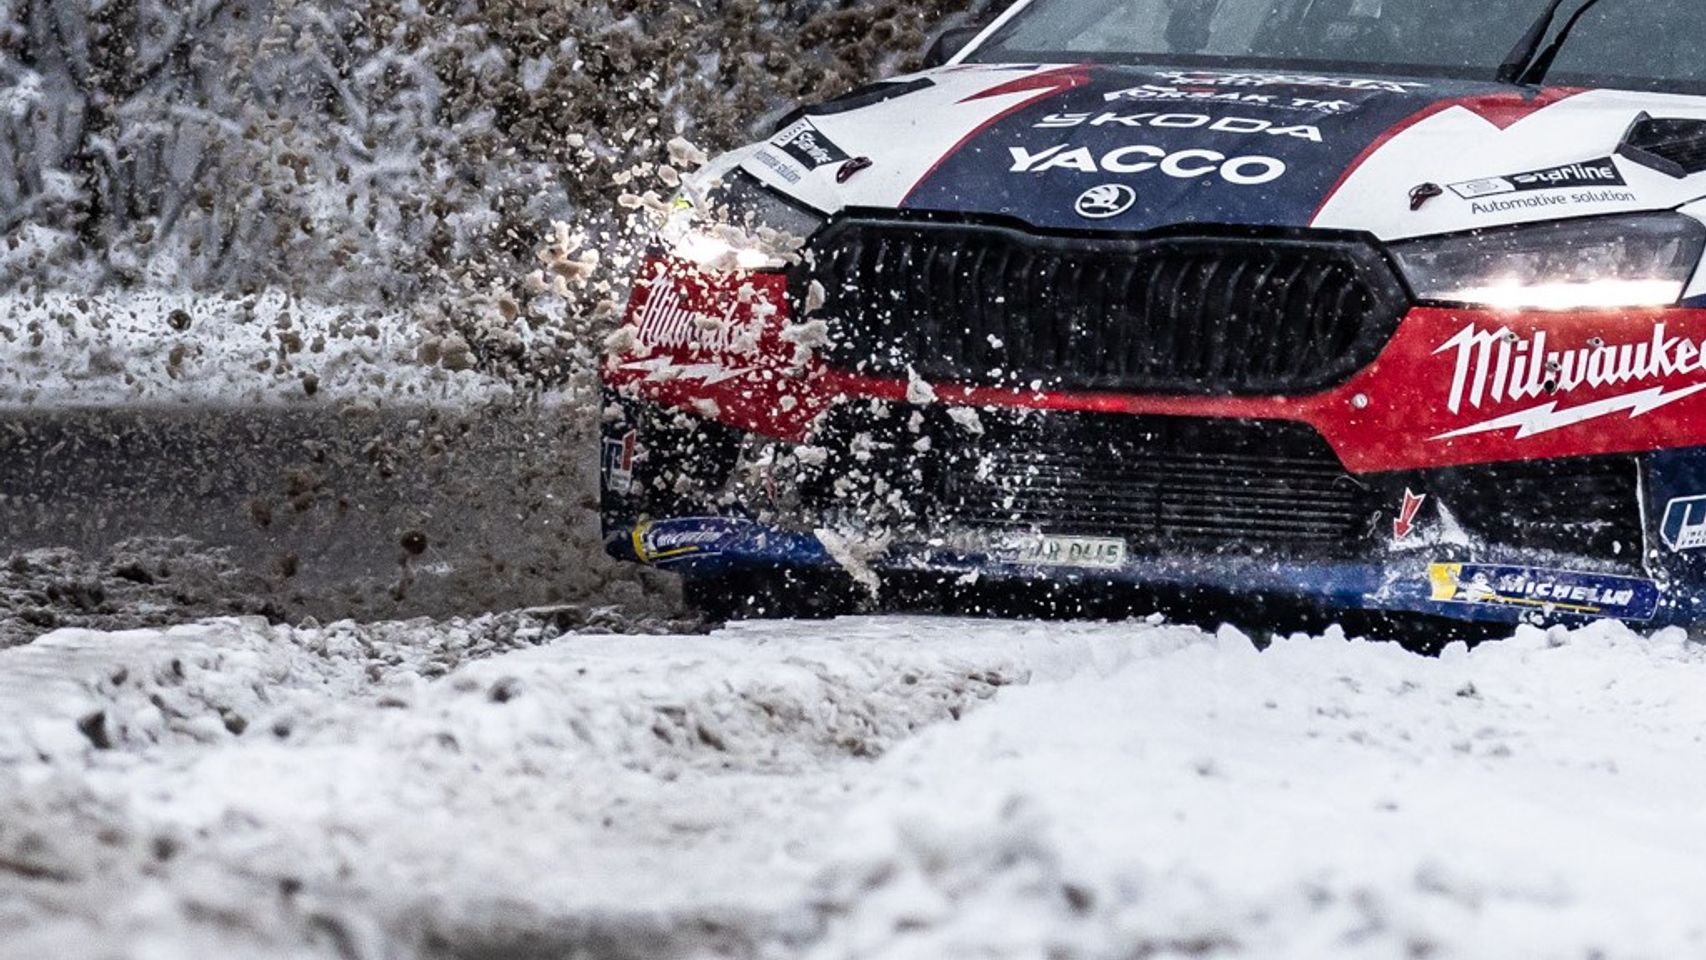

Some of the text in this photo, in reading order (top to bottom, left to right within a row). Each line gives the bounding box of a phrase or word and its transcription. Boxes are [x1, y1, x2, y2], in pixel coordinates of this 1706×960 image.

[1008, 143, 1287, 185] YACCO
[1471, 189, 1637, 215] Automotive solution
